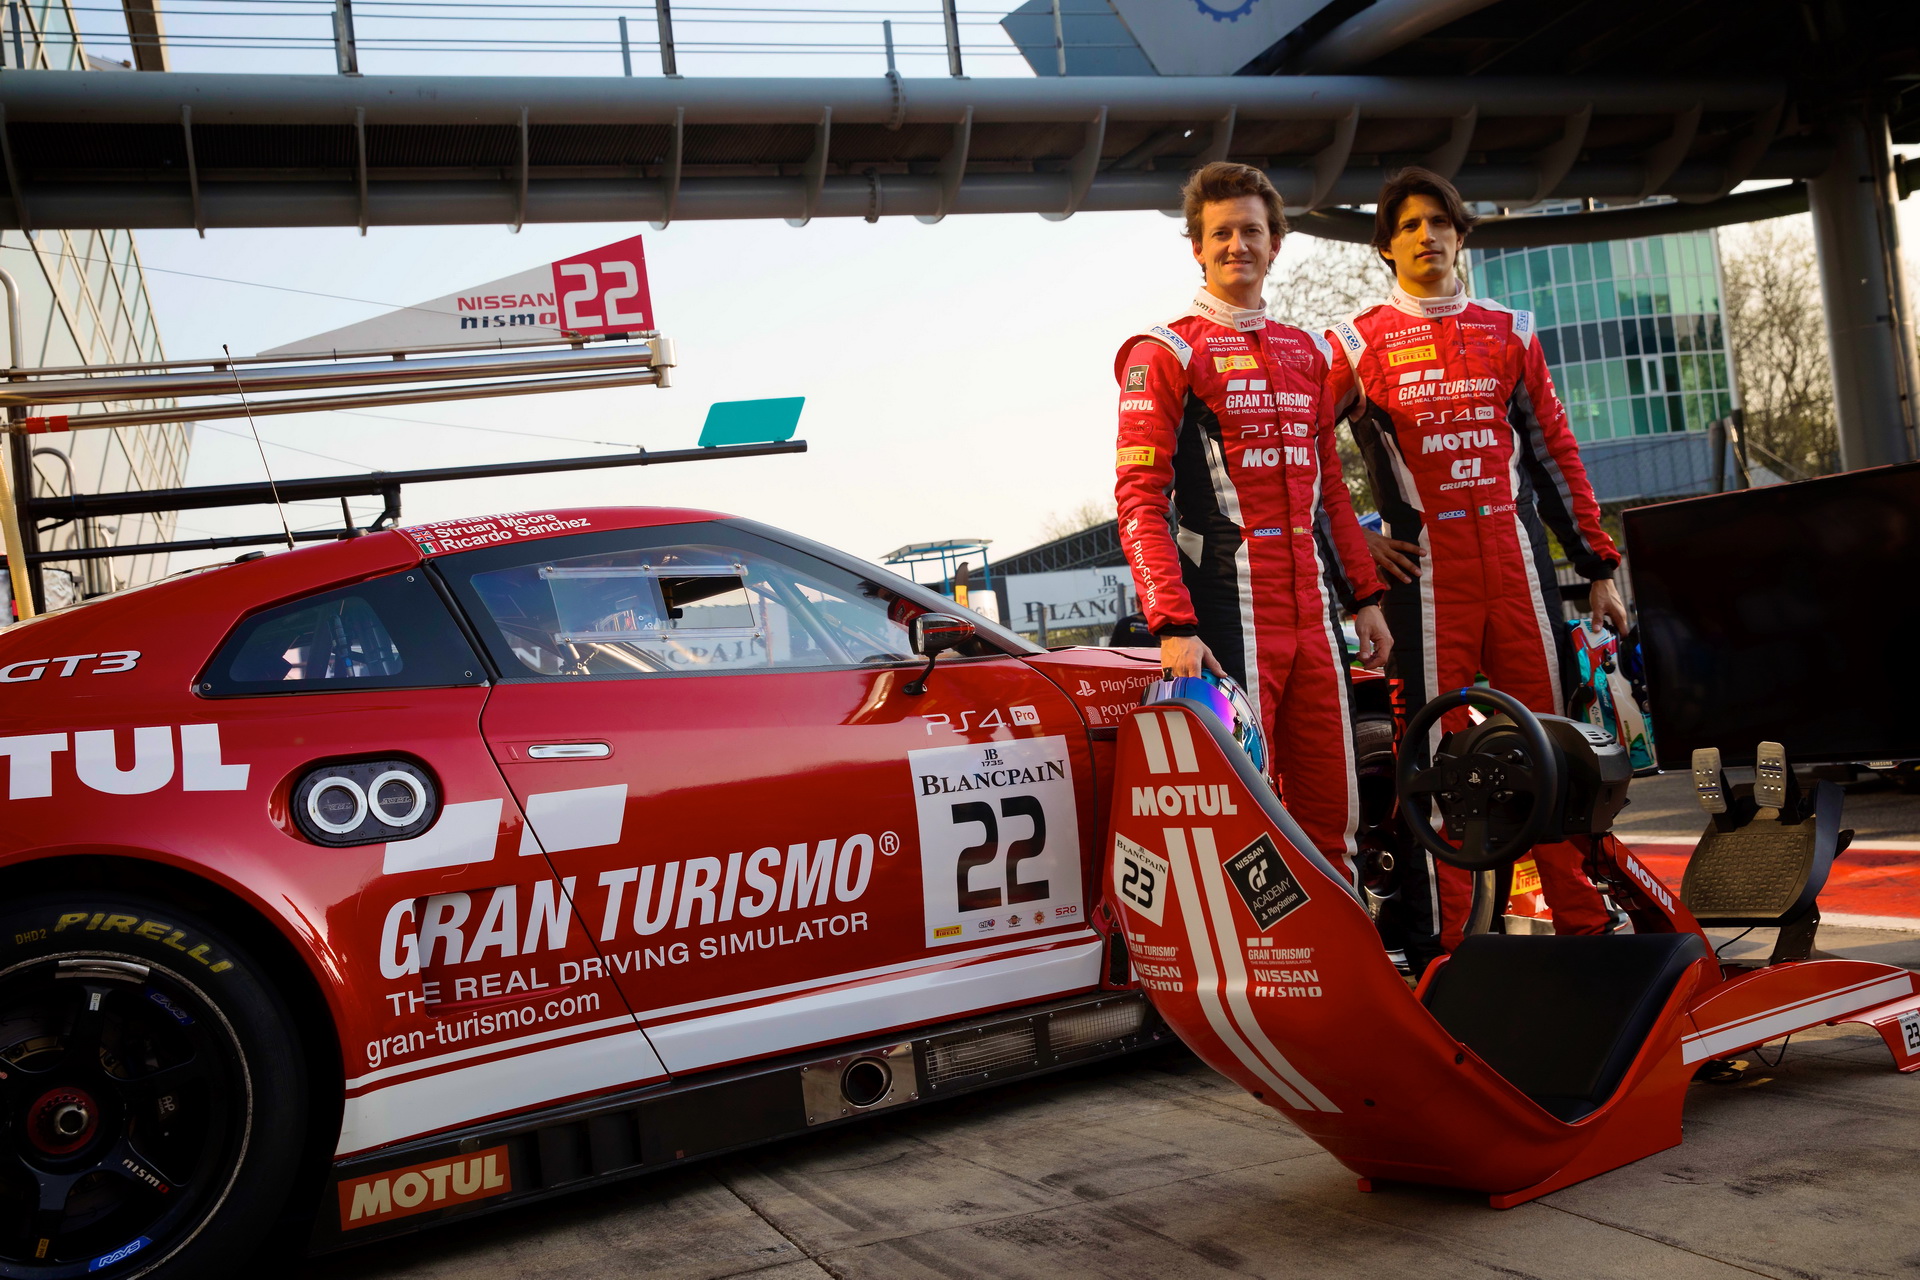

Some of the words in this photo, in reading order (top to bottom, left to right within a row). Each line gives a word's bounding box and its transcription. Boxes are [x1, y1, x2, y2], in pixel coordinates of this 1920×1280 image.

[457, 292, 555, 311] NISSAN
[560, 260, 644, 329] 22
[461, 312, 557, 329] nismo
[1240, 315, 1266, 329] NISS
[1384, 324, 1431, 340] nismo
[1386, 340, 1406, 349] NISMO
[1407, 334, 1433, 344] ATHLETE
[1393, 348, 1431, 363] PIRELLI
[1226, 394, 1260, 409] GRAN
[1262, 392, 1310, 407] TURISMO
[1398, 383, 1436, 401] GRAN
[1439, 378, 1497, 395] TURISMO
[1415, 408, 1473, 427] PS4
[1478, 409, 1492, 417] Pro
[1241, 423, 1293, 439] PS4
[1422, 428, 1498, 455] MOTUL
[1119, 452, 1150, 463] RELLI
[1242, 446, 1310, 468] MOTUL
[1451, 457, 1482, 480] GI
[1440, 480, 1475, 491] GRUPO
[1477, 477, 1497, 486] INDI
[1438, 509, 1466, 520] sparco
[1492, 503, 1517, 513] SANCHEZ
[434, 518, 498, 539] Struan
[498, 513, 557, 529] Moore
[440, 529, 513, 551] Ricardo
[514, 517, 591, 537] Sanchez
[1131, 539, 1157, 610] PlayStation
[0, 650, 142, 684] GT3
[1100, 673, 1162, 694] PlayStatio
[922, 708, 1008, 736] PS4
[1014, 710, 1035, 722] Pro
[0, 723, 251, 801] TUL
[981, 759, 1004, 767] 1735
[919, 759, 1066, 797] BLANCPAIN
[1132, 784, 1238, 817] MOTUL
[951, 795, 1050, 914] 22
[1116, 839, 1167, 875] BLANCPAIN
[1234, 845, 1265, 871] NISSAN
[1122, 857, 1155, 909] 23
[1515, 866, 1541, 890] PIREL
[1626, 854, 1676, 915] MOTUL
[1252, 877, 1291, 912] ACADEMY
[1267, 892, 1299, 917] PlayStation
[1055, 905, 1077, 916] SRO
[379, 877, 577, 980] GRAN
[54, 912, 235, 973] PIRELLI
[1144, 945, 1176, 957] TURISMO
[1248, 949, 1270, 960] GRAN
[1271, 947, 1311, 960] TURISMO
[386, 981, 441, 1017] THE
[454, 966, 550, 1002] REAL
[560, 941, 690, 986] DRIVING
[699, 911, 868, 960] SIMULATOR
[1134, 960, 1182, 979] NISSAN
[1253, 969, 1319, 983] NISSAN
[1255, 986, 1323, 998] nismo
[366, 989, 600, 1068] gran-turismo.com
[1905, 1022, 1920, 1050] 23
[122, 1157, 171, 1195] nismo
[348, 1153, 505, 1221] MOTUL
[98, 1239, 141, 1268] RAYS
